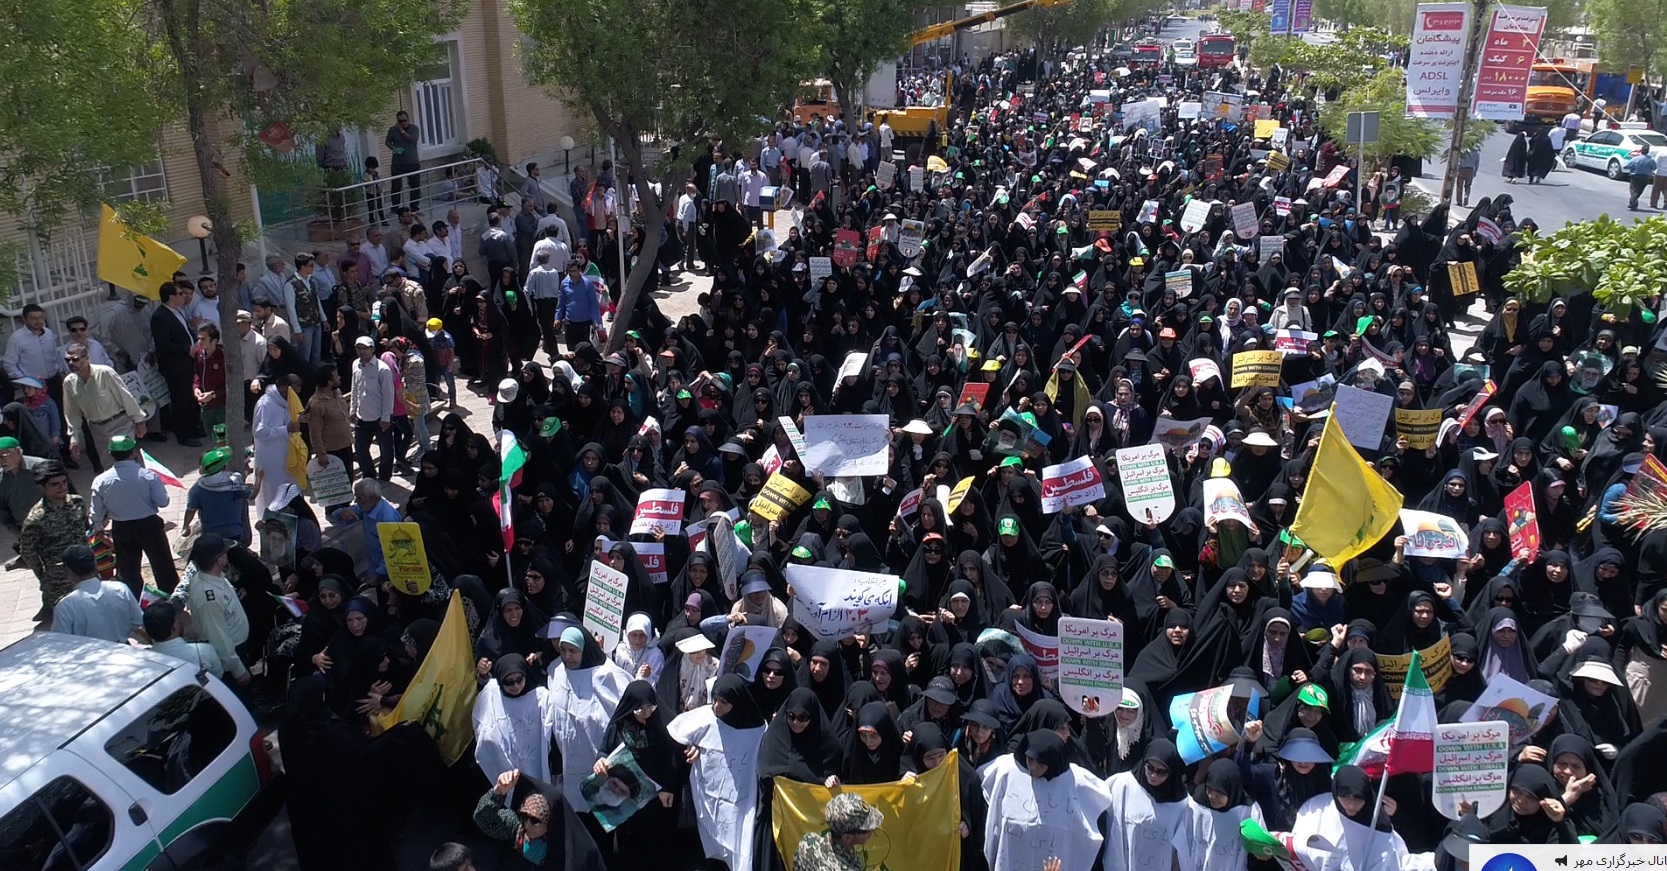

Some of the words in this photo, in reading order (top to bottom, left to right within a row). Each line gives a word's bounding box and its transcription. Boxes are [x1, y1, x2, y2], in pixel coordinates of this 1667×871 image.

[1417, 34, 1461, 45] پیشگامان
[1516, 56, 1525, 65] ۶
[1419, 72, 1448, 80] ADSL
[1494, 71, 1525, 82] ۱۸۰۰۰
[1413, 86, 1450, 95] وایرلس
[1266, 354, 1280, 362] مرگ
[1148, 450, 1159, 458] مرگ
[1124, 469, 1144, 479] اسرائیل
[1044, 468, 1094, 497] فلسطین
[763, 489, 779, 501] DOWN
[1085, 488, 1098, 497] آزاد
[1128, 485, 1148, 496] انگلیس
[635, 501, 679, 518] فلسطین
[665, 522, 676, 530] آزاد
[613, 578, 623, 587] مرگ
[611, 596, 621, 606] مرگ
[609, 615, 618, 624] مرگ
[1065, 625, 1089, 635] امریکا
[1101, 628, 1117, 638] مرگ
[1084, 639, 1100, 647] WITH
[1063, 646, 1091, 657] اسرائیل
[1103, 650, 1119, 660] مرگ
[1431, 644, 1447, 658] مرگ
[1063, 668, 1092, 678] انگلیس
[1103, 670, 1119, 680] مرگ
[1442, 731, 1469, 742] امریکا
[1471, 733, 1480, 741] بر
[1482, 729, 1501, 740] مرگ
[1439, 753, 1470, 764] اسرائیل
[1472, 755, 1481, 763] بر
[1484, 751, 1503, 761] مرگ
[1439, 774, 1472, 786] انگلیس
[1474, 776, 1482, 784] بر
[1484, 772, 1502, 782] مرگ
